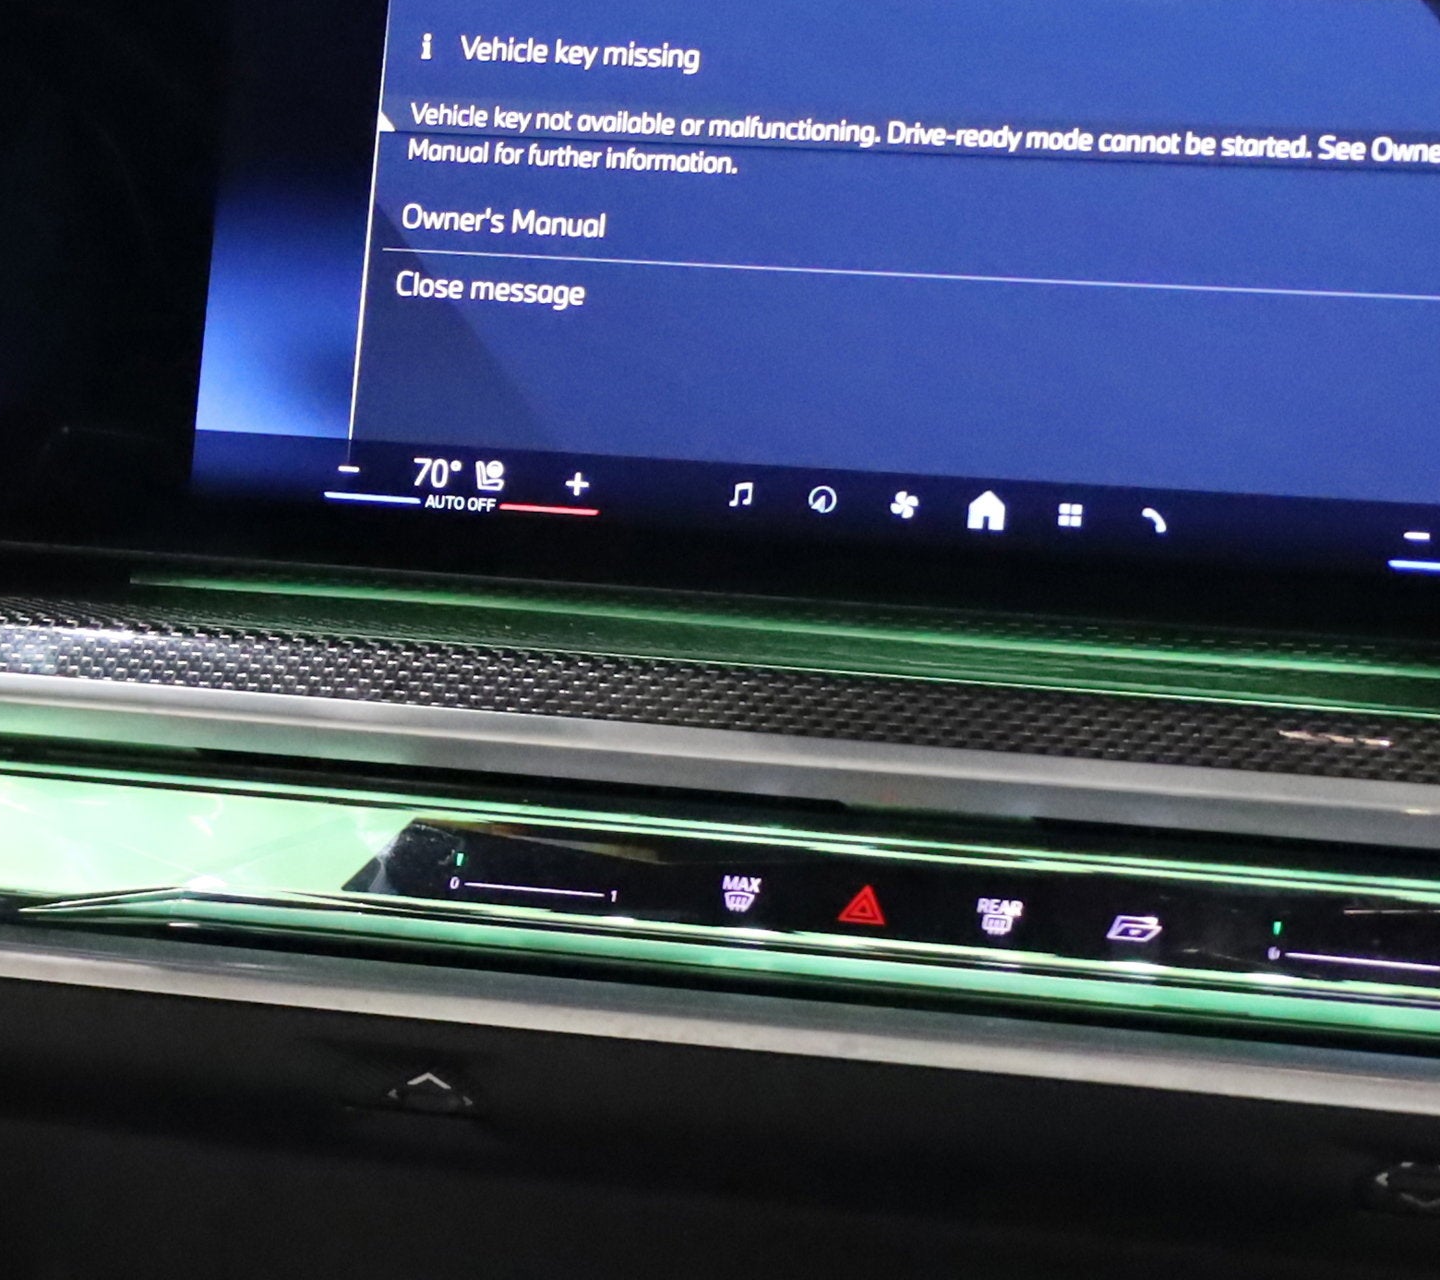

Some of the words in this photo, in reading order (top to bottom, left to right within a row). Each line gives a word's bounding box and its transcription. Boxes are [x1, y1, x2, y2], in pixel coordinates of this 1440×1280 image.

[460, 34, 549, 64] Vehicle
[554, 37, 599, 71] key
[602, 41, 701, 75] missing
[410, 102, 489, 128] Vehicle
[493, 105, 533, 134] key
[535, 109, 574, 131] not
[576, 110, 676, 137] available
[679, 117, 705, 137] or
[708, 115, 881, 149] malfunctioning.
[887, 120, 1023, 153] Drive-ready
[1025, 127, 1094, 152] mode
[1098, 131, 1181, 155] cannot
[1184, 132, 1217, 156] be
[1220, 134, 1313, 159] started.
[1317, 134, 1367, 161] See
[408, 139, 490, 165] Manual
[493, 141, 526, 165] for
[527, 143, 600, 170] further
[605, 147, 738, 175] information.
[402, 202, 505, 234] Owner's
[511, 208, 607, 239] Manual
[395, 270, 465, 300] Close
[469, 278, 586, 310] message
[413, 457, 463, 489] 70°
[424, 494, 465, 511] AUTO
[467, 497, 497, 513] OFF
[722, 874, 762, 894] MAX
[976, 897, 1024, 917] REAR
